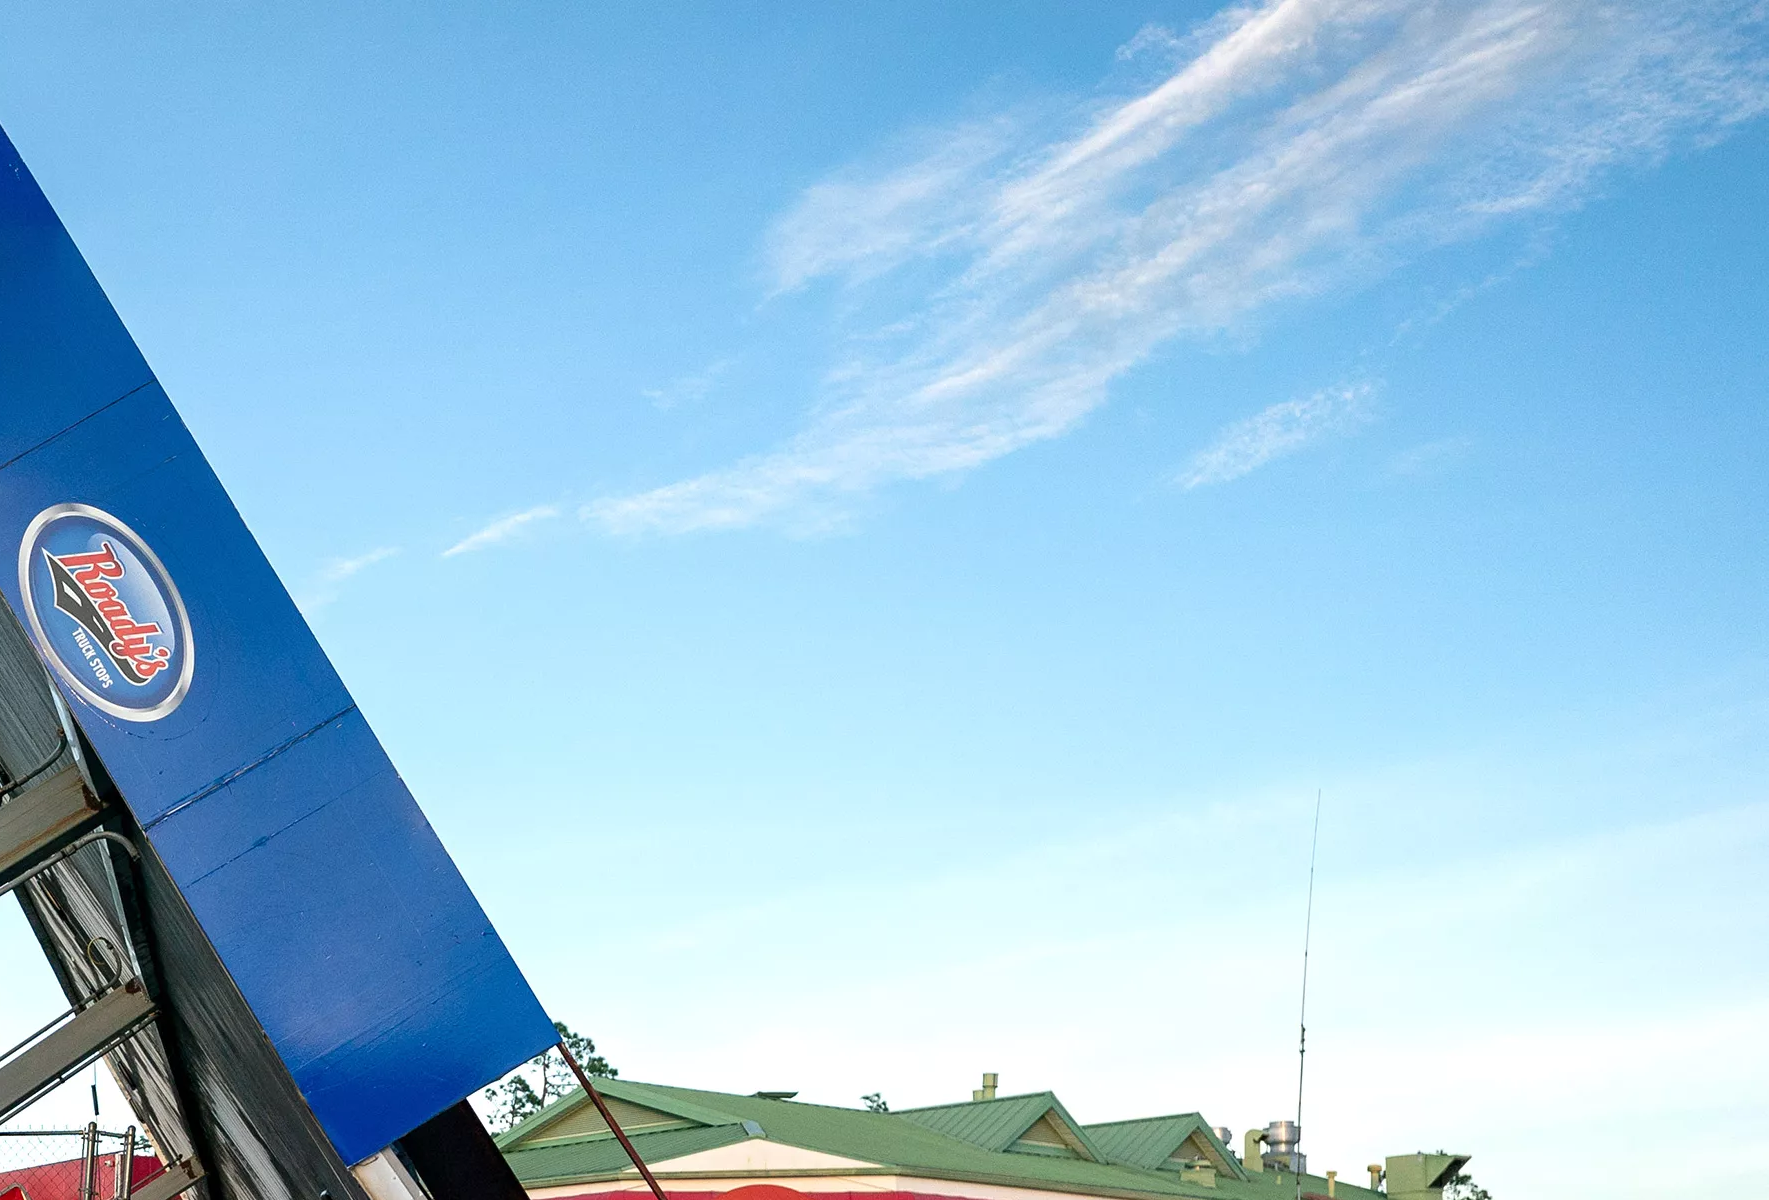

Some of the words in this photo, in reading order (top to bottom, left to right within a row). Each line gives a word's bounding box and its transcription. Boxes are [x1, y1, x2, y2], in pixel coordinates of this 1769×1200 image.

[56, 541, 171, 679] Roady's
[71, 626, 95, 660] TRUCK
[89, 656, 114, 689] STOPS
